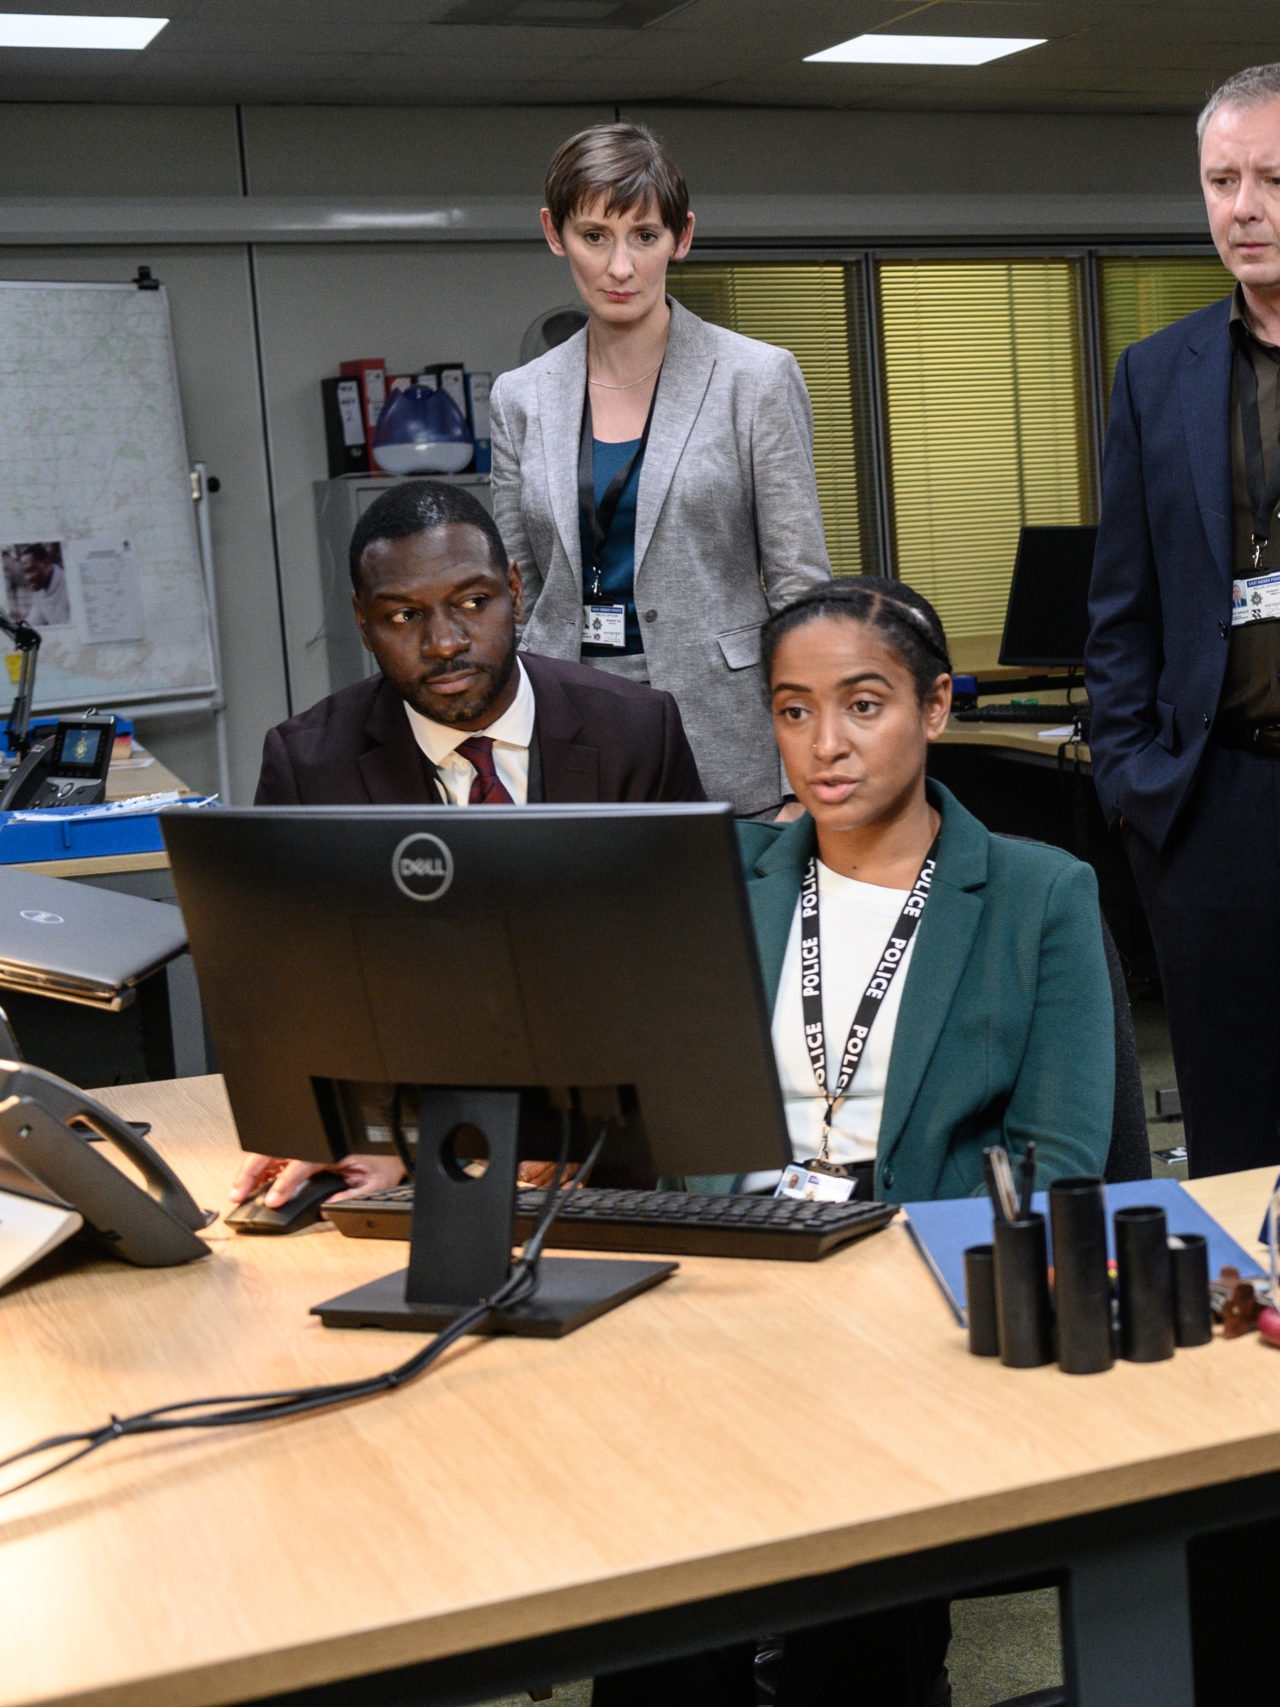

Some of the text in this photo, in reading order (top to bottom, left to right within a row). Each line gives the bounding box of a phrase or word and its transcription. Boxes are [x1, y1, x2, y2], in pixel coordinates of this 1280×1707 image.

[400, 858, 445, 877] DELL
[802, 937, 820, 998] POLICE
[866, 937, 907, 1000] POLICE
